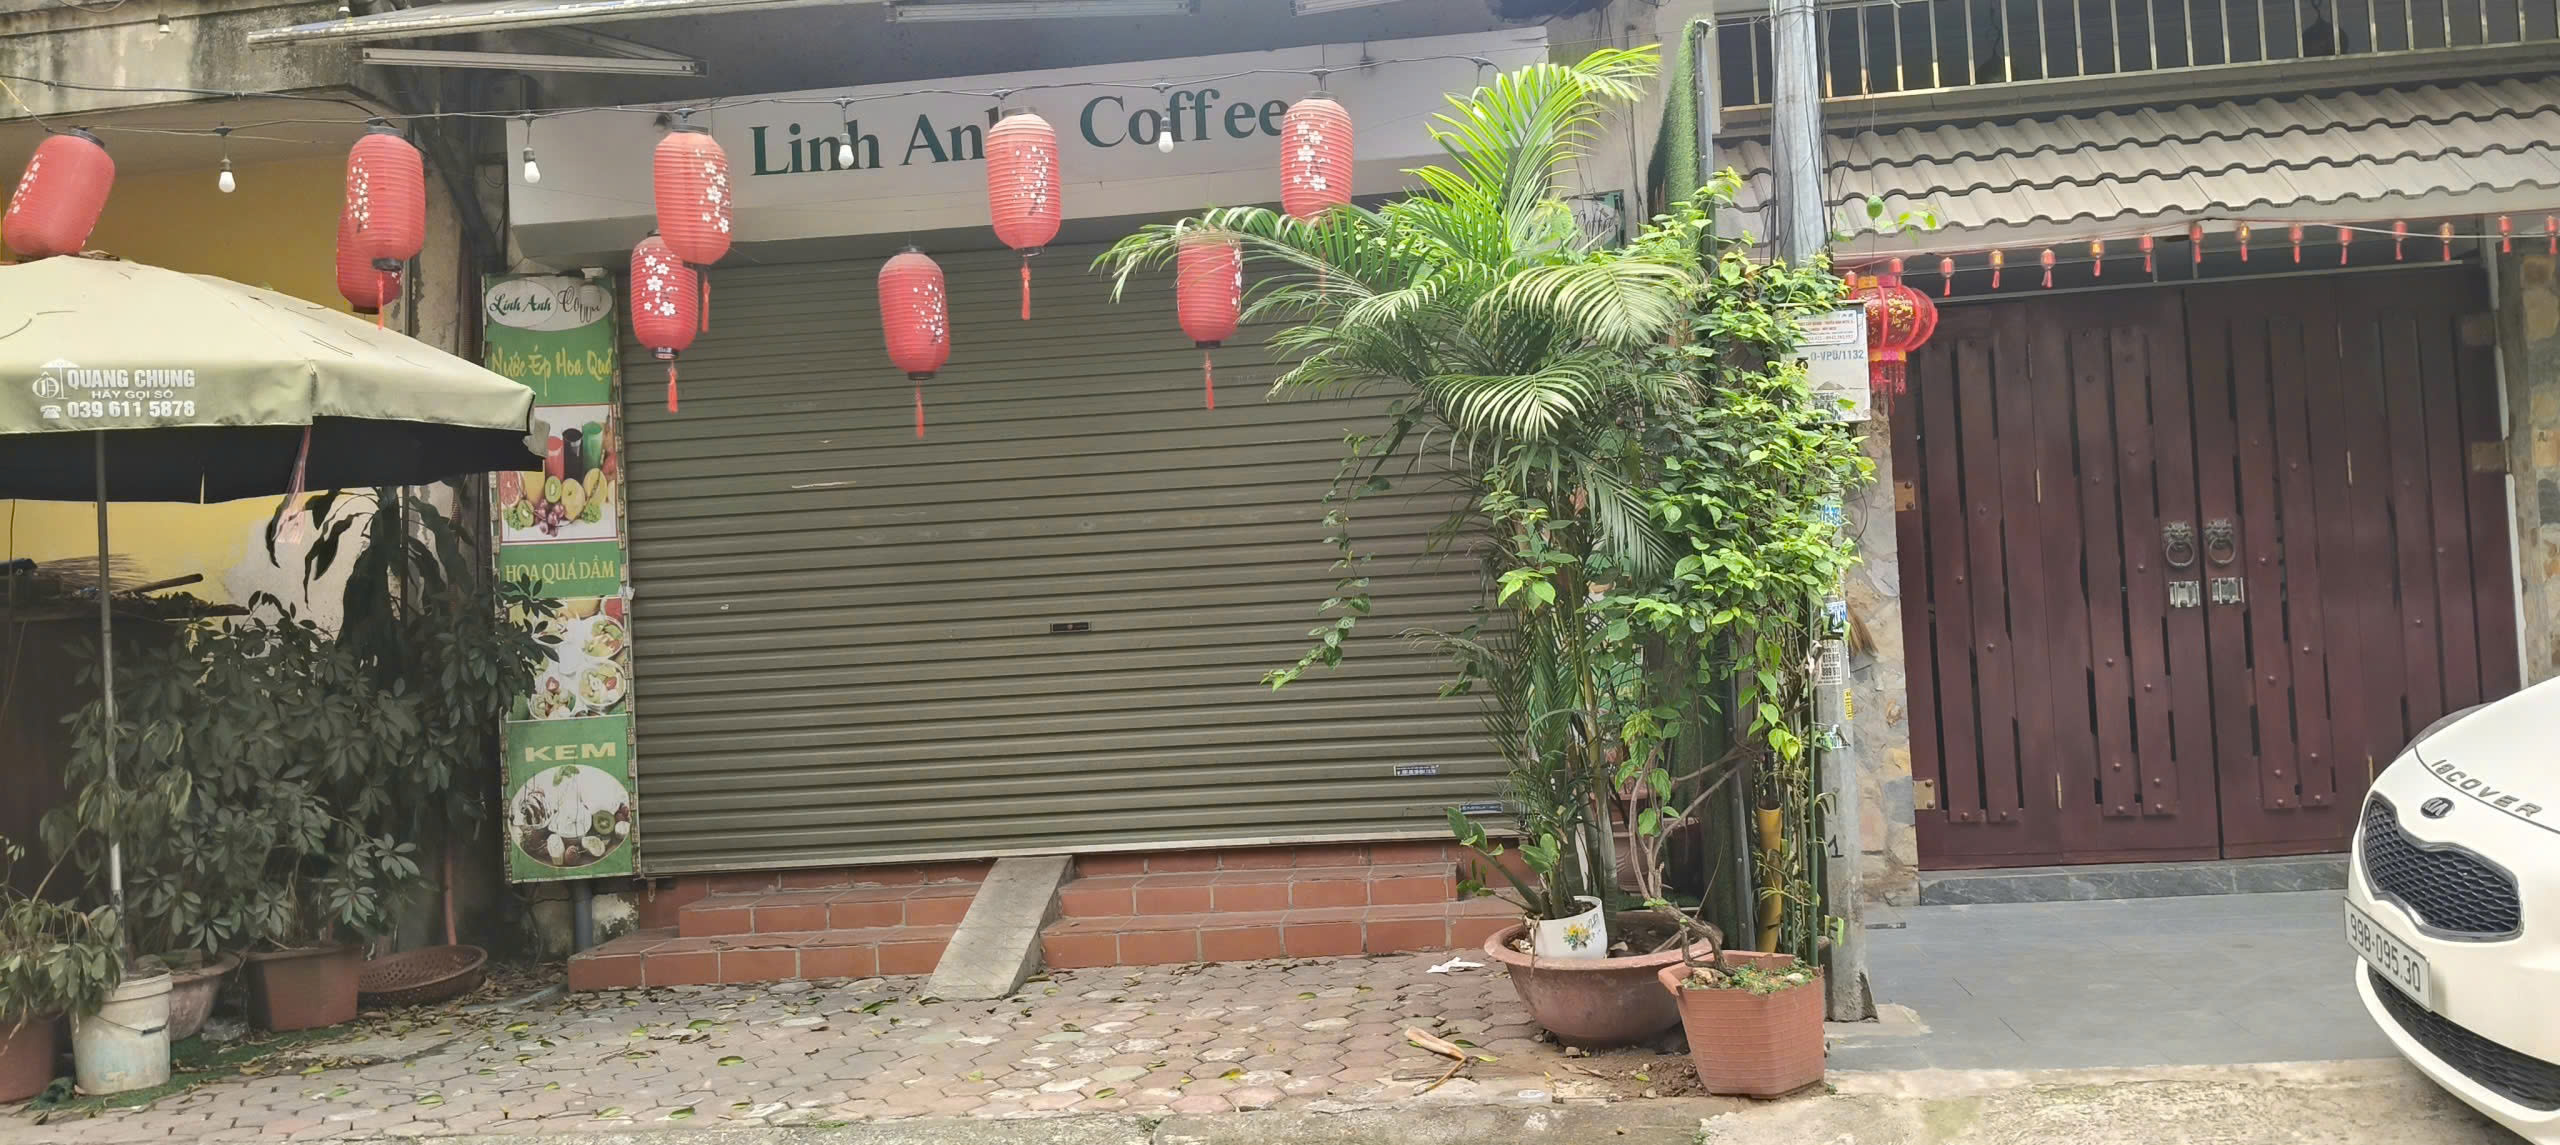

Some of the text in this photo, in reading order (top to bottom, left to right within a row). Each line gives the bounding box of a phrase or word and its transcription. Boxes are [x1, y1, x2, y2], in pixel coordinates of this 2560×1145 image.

[750, 119, 885, 177] Linh
[1080, 89, 1287, 149] Coffee
[489, 294, 521, 316] Linh
[522, 294, 552, 313] Anh
[67, 369, 128, 390] QUANG
[135, 369, 195, 388] CHUNG
[491, 346, 527, 378] Nước
[527, 344, 553, 397] Ép
[555, 347, 584, 377] Hoa
[124, 390, 150, 400] GỌI
[67, 400, 195, 418] 039 611 5878
[504, 563, 539, 583] HOA
[525, 742, 616, 763] KEM
[2423, 796, 2450, 817] KIA
[2350, 914, 2421, 993] 99B-095.30
